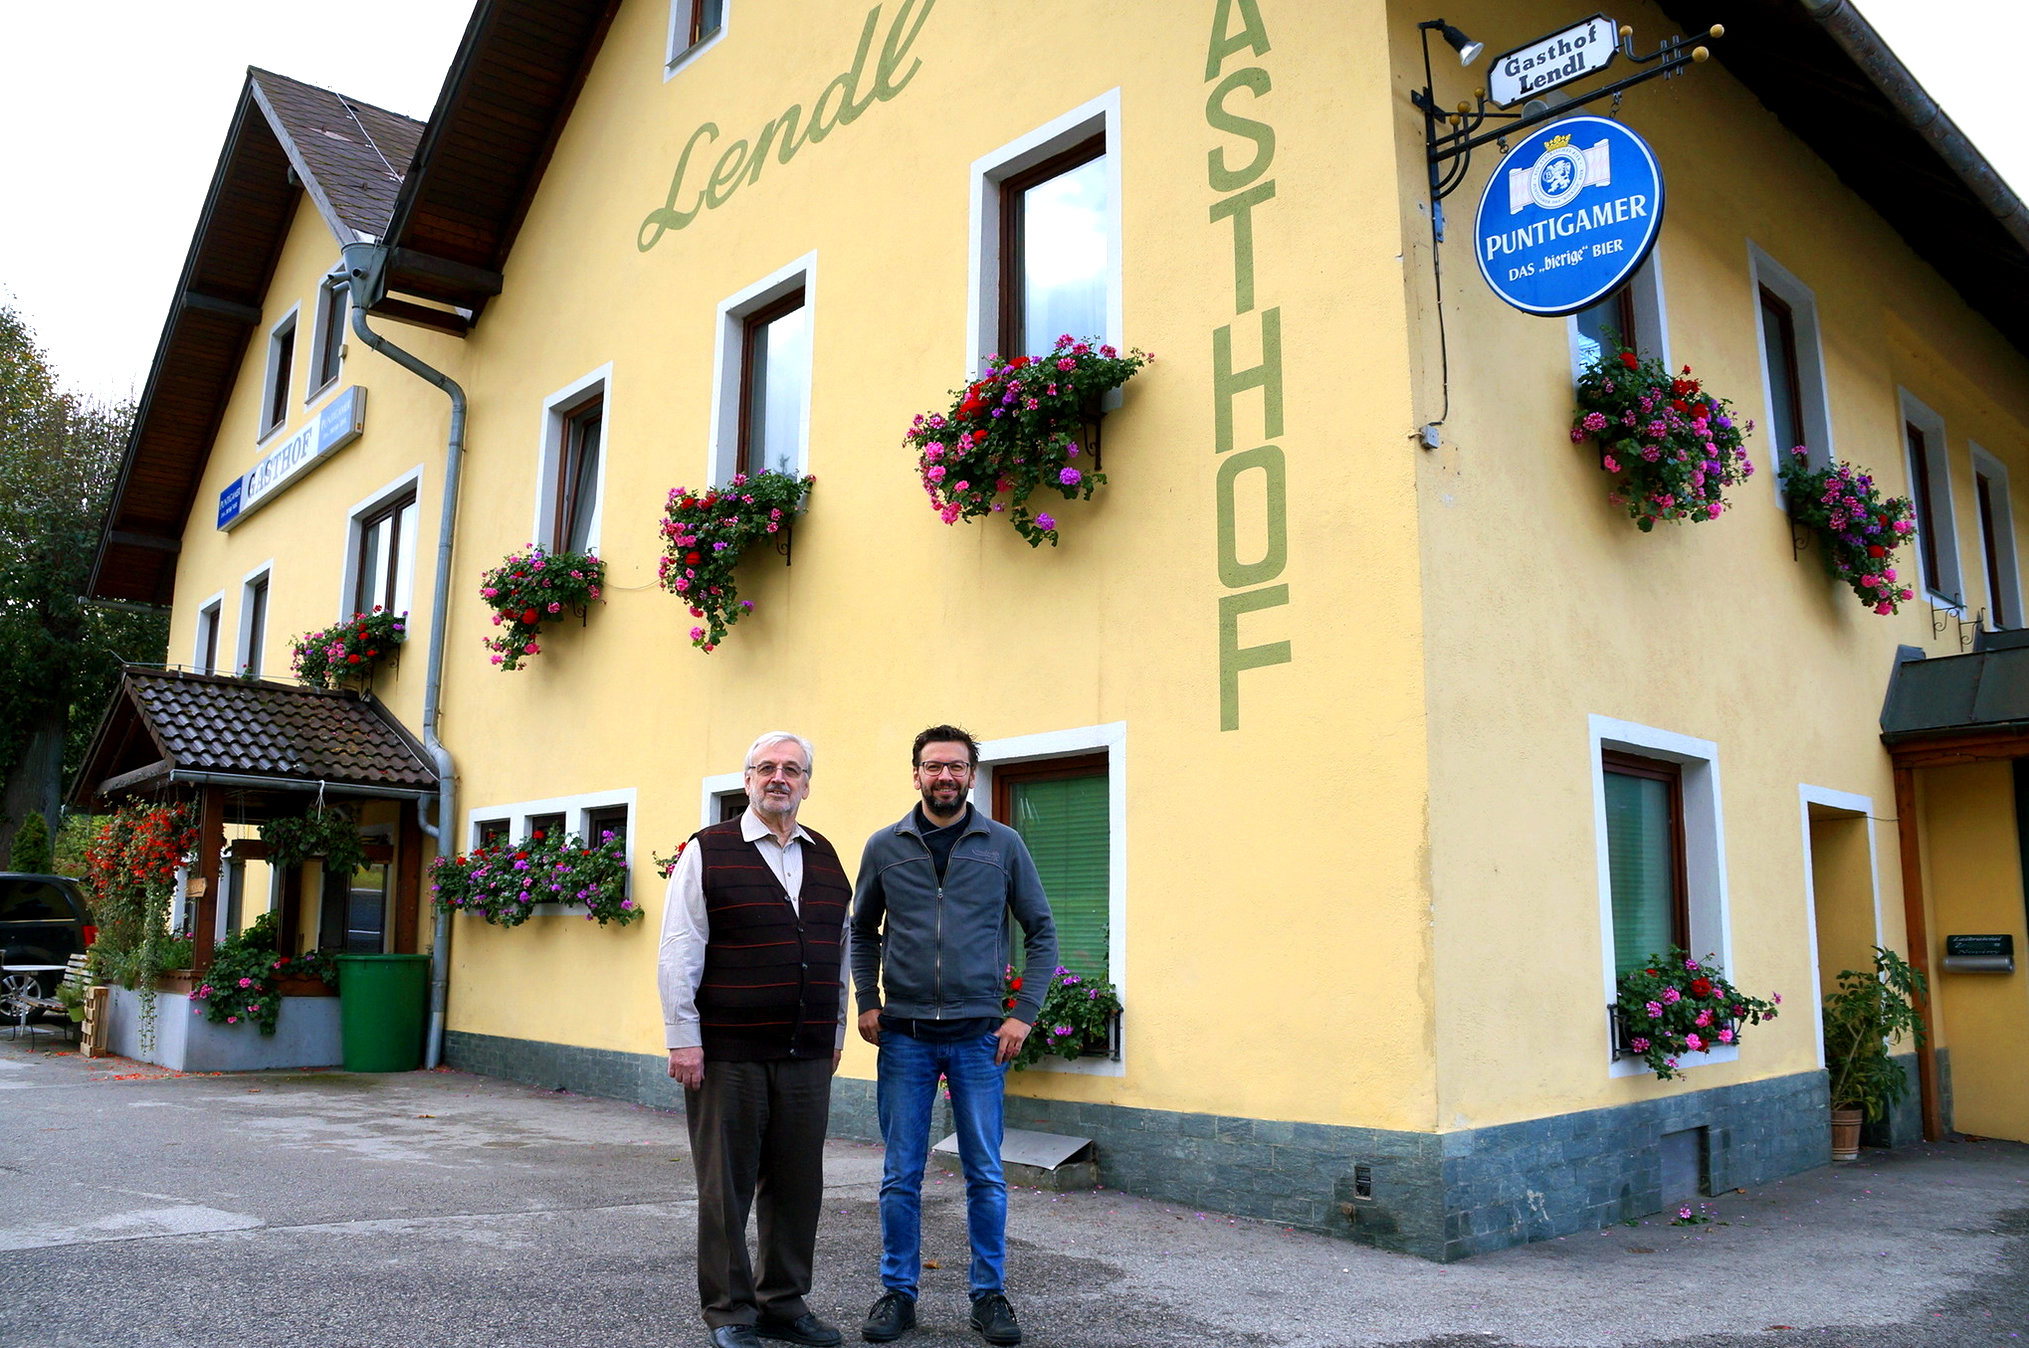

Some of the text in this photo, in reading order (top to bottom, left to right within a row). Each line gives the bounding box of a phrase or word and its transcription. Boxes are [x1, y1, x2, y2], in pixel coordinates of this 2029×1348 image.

[1504, 24, 1597, 78] Gasthof
[1519, 51, 1586, 95] Lendl
[637, 0, 936, 253] Lendl
[1486, 194, 1648, 262] PUNTIGAMER
[1508, 262, 1535, 282] DAS
[1592, 238, 1624, 258] BIER
[247, 426, 313, 499] GASTHOF
